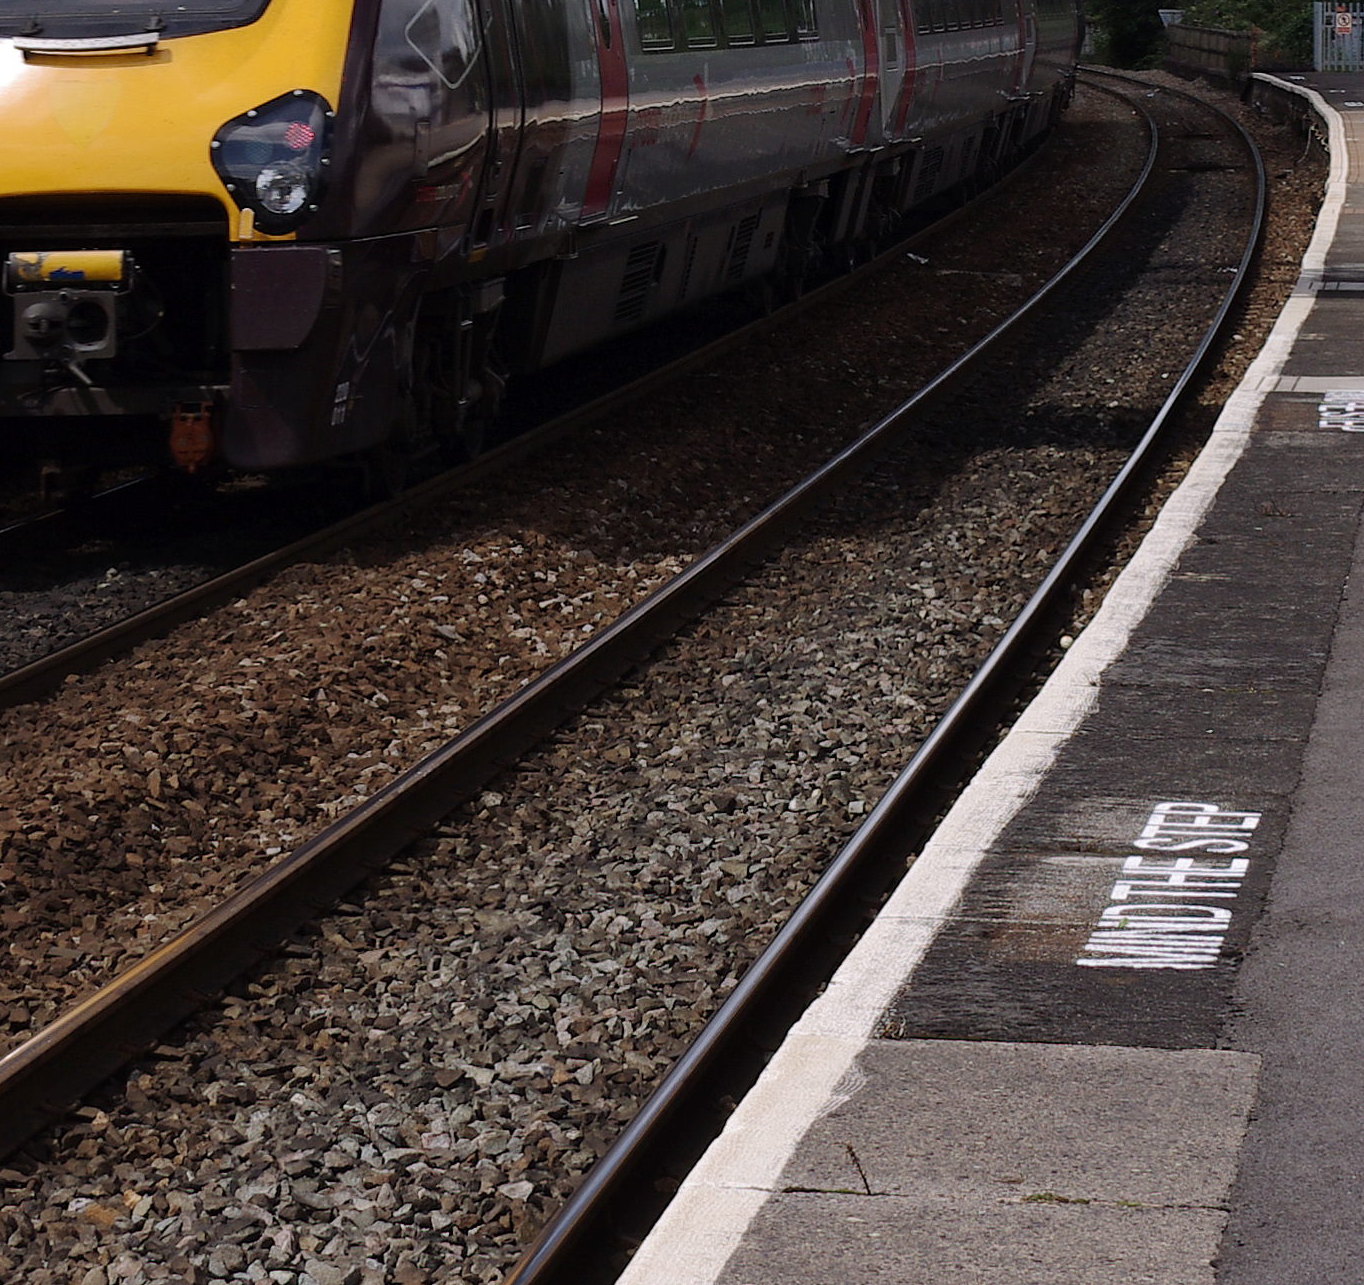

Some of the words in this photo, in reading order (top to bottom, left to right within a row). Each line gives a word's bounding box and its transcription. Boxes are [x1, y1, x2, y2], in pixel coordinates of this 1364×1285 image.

[1132, 800, 1263, 854] STEP
[1110, 855, 1251, 901] THE
[1076, 903, 1233, 970] MIND
